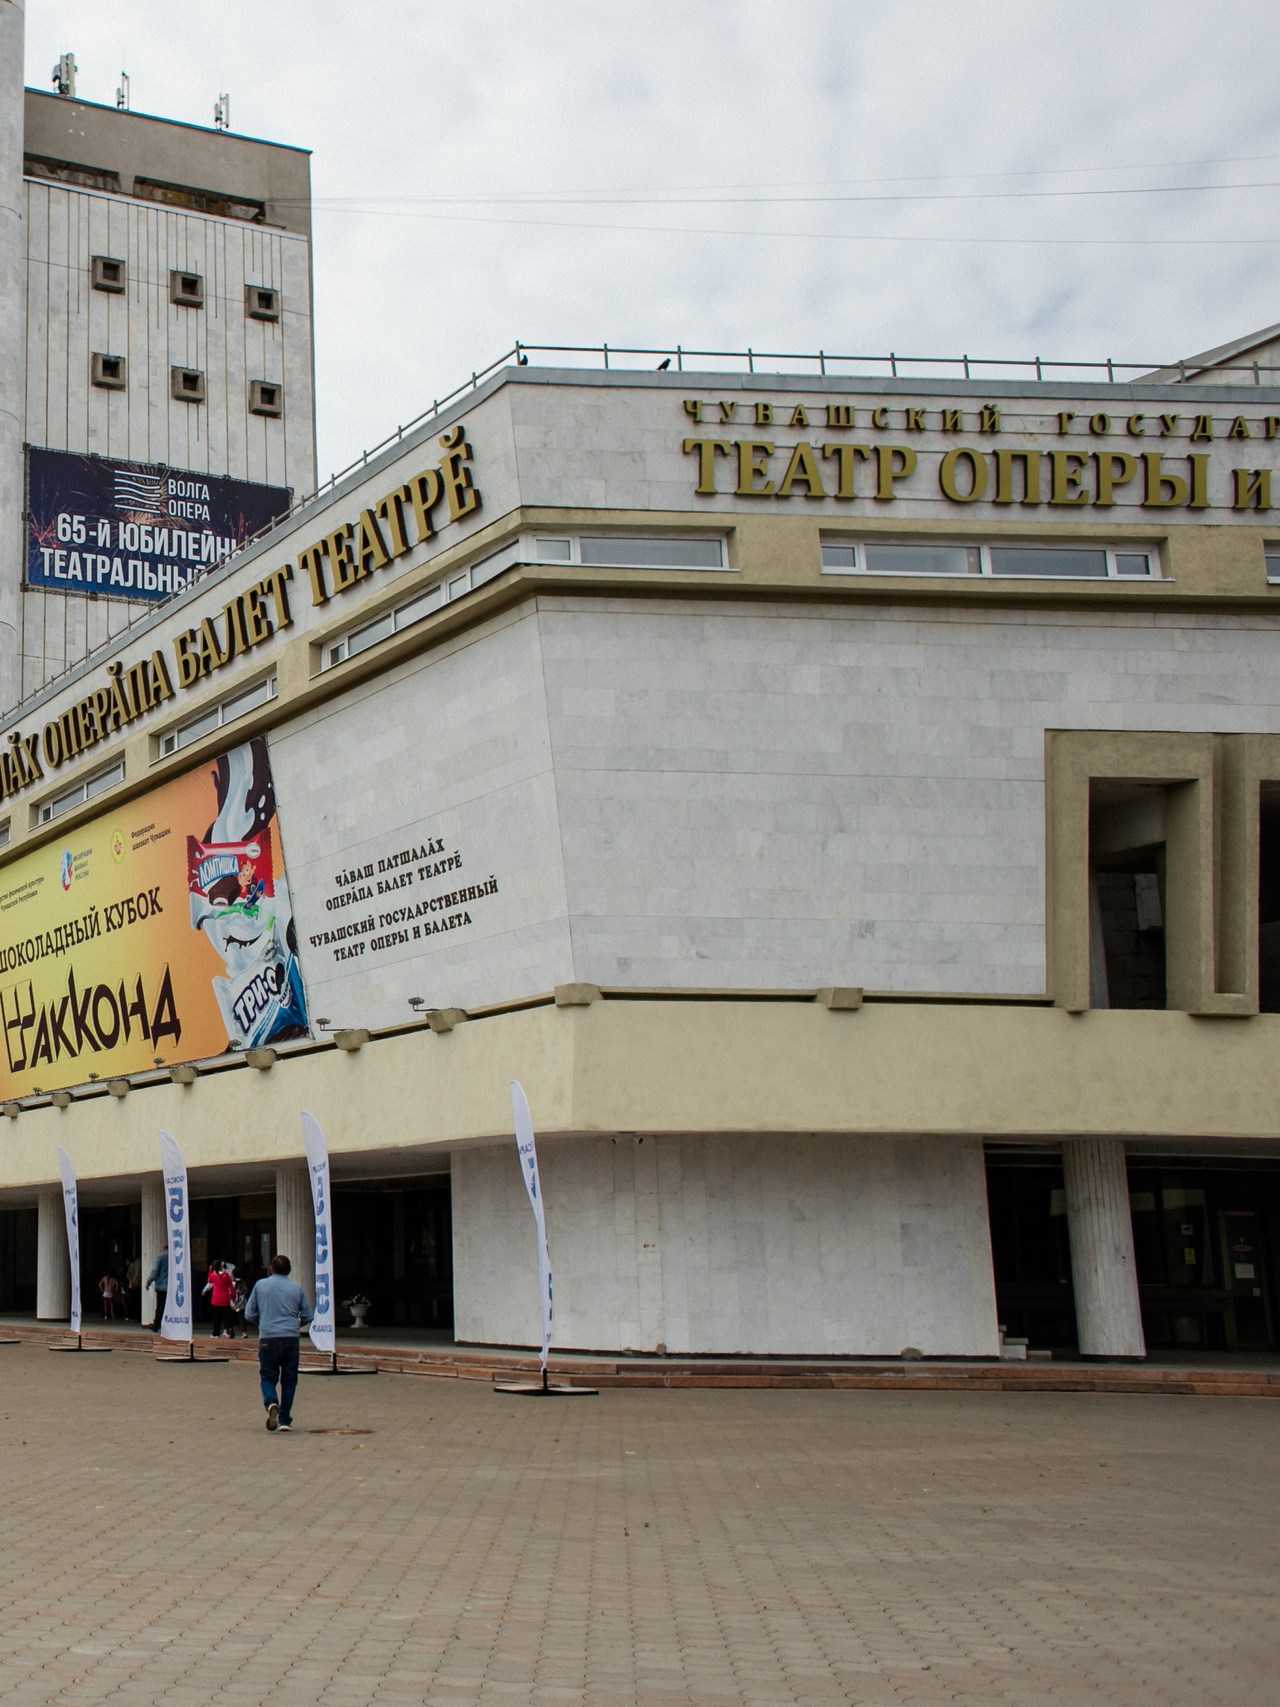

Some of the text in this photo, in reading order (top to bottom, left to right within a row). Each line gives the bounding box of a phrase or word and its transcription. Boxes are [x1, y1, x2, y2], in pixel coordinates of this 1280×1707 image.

[682, 400, 1002, 433] ЧУВАШСКИЙ
[167, 478, 210, 501] ВОЛГА
[682, 437, 918, 501] ТЕАТР
[939, 446, 1212, 509] ОПЕРЫ
[167, 500, 211, 522] ОПЕРА
[118, 521, 260, 570] ЮБИЛЕЙНЫ
[172, 564, 295, 689] БАЛЕТ
[377, 871, 413, 895] БАЛЕТ
[103, 886, 163, 933] КУБОК
[309, 874, 499, 948] ЧУВАШСКИЙ ГОСУДАРСТВЕННЫЙ
[333, 911, 473, 962] ТЕАТР ОПЕРЫ И БАЛЕТА
